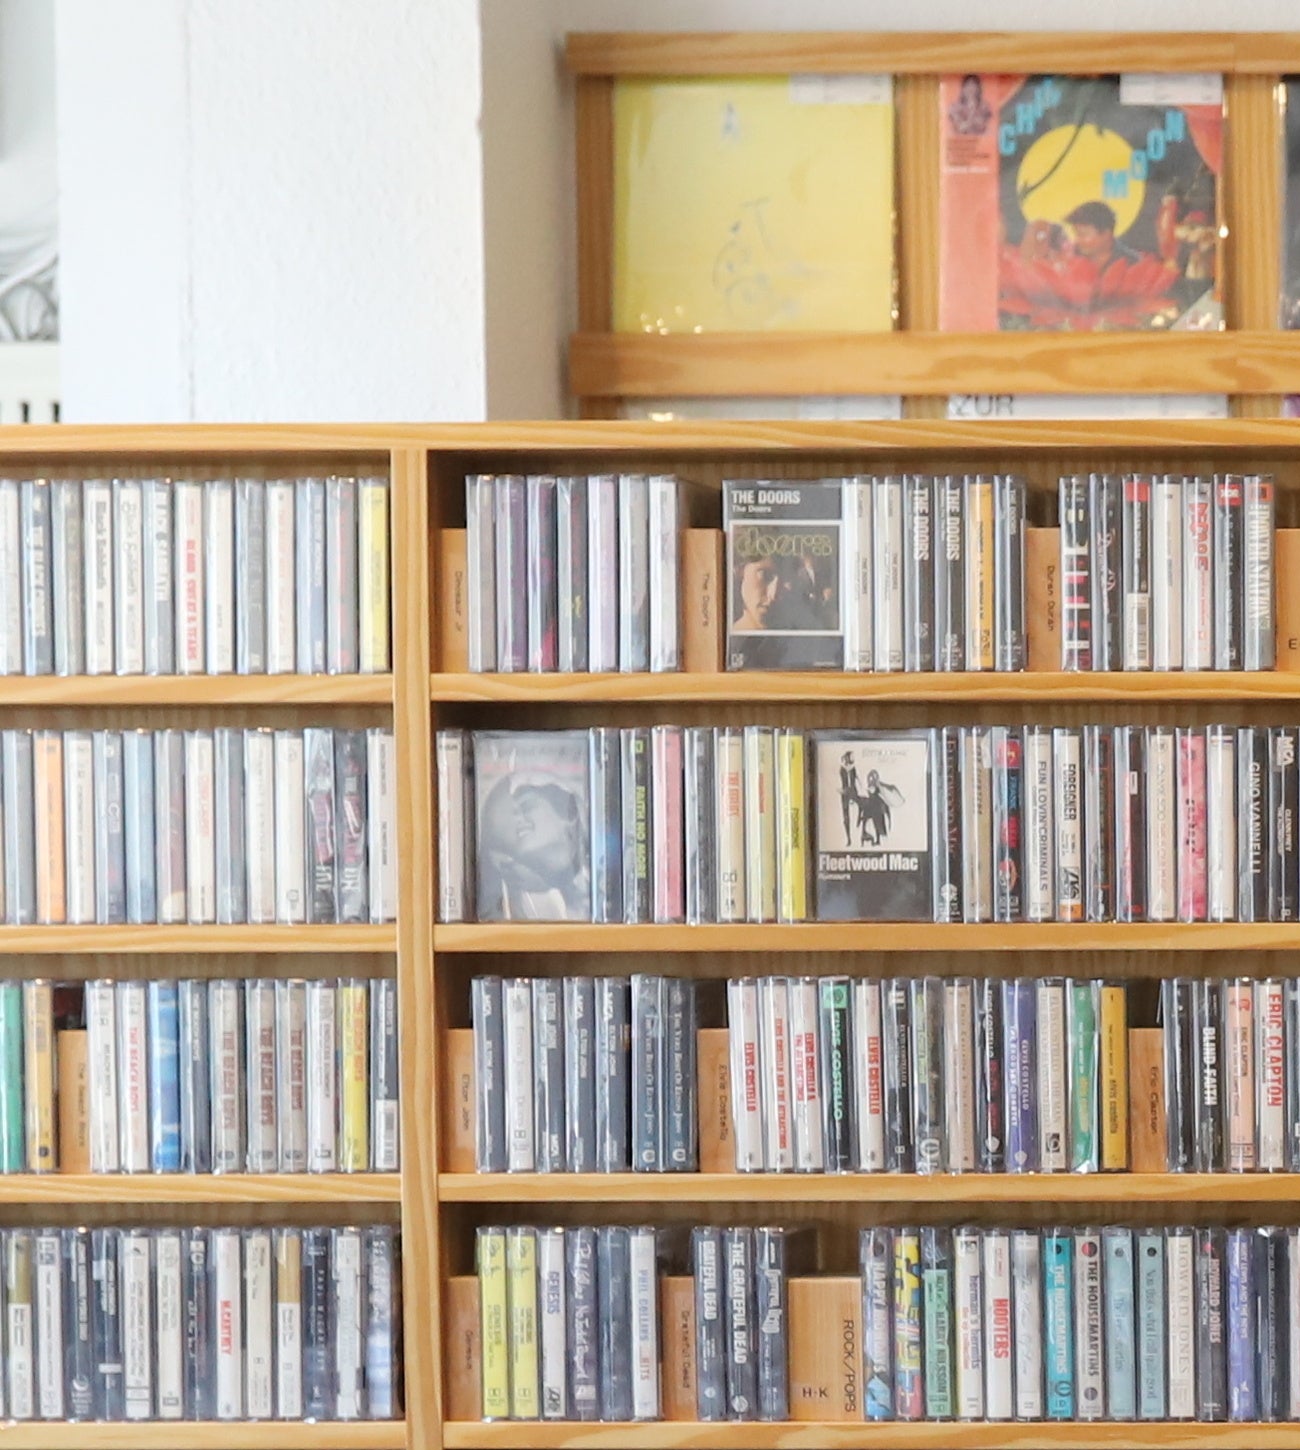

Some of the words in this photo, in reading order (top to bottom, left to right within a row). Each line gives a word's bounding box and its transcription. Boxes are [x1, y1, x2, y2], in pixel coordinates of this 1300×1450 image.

[1102, 110, 1186, 199] MOON
[732, 491, 756, 504] THE
[759, 491, 800, 504] DOORS
[702, 573, 710, 592] The
[702, 598, 710, 627] Doors
[1064, 764, 1076, 821] FOREIGNER
[1249, 762, 1260, 798] GINO
[636, 787, 646, 819] FAITH
[636, 823, 646, 840] NO
[1249, 803, 1260, 873] VANNELLI
[636, 843, 646, 878] MORE
[819, 855, 887, 870] Fleetwood
[890, 855, 918, 870] Mac
[1267, 994, 1282, 1030] ERIC
[1203, 1027, 1216, 1065] BLIND
[1203, 1069, 1216, 1105] FAITH
[1267, 1037, 1282, 1106] CLAPTON
[732, 1242, 746, 1266] THE
[1087, 1261, 1099, 1282] THE
[732, 1269, 746, 1328] GRATEFUL
[994, 1298, 1008, 1358] HOOTERS
[1087, 1285, 1099, 1376] HOUSEMARTINS
[732, 1332, 746, 1363] DEAD
[843, 1319, 856, 1412] ROCK/POPS
